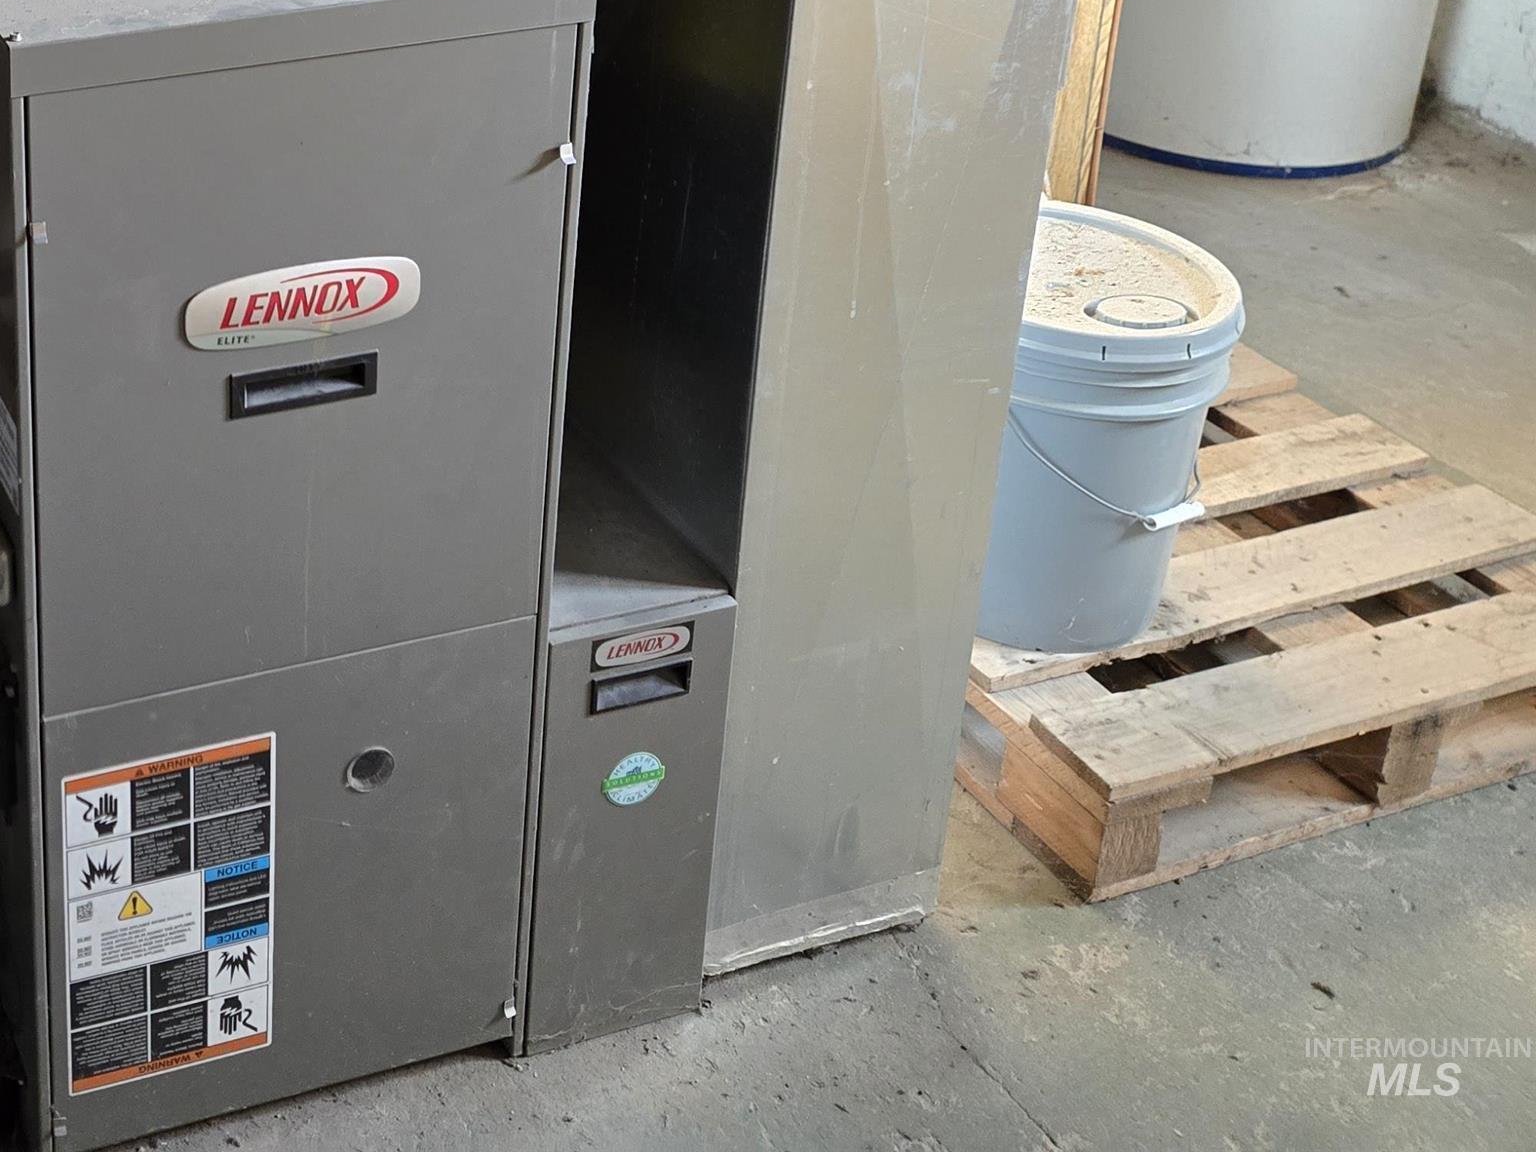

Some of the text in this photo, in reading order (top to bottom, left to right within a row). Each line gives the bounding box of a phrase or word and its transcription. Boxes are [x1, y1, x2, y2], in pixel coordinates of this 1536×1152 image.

[220, 276, 366, 330] LENNOX
[606, 636, 666, 660] LENNOX
[147, 754, 204, 774] WARNING
[217, 861, 257, 877] NOTICE
[217, 927, 257, 944] NOTICE
[139, 1054, 191, 1073] WARNING
